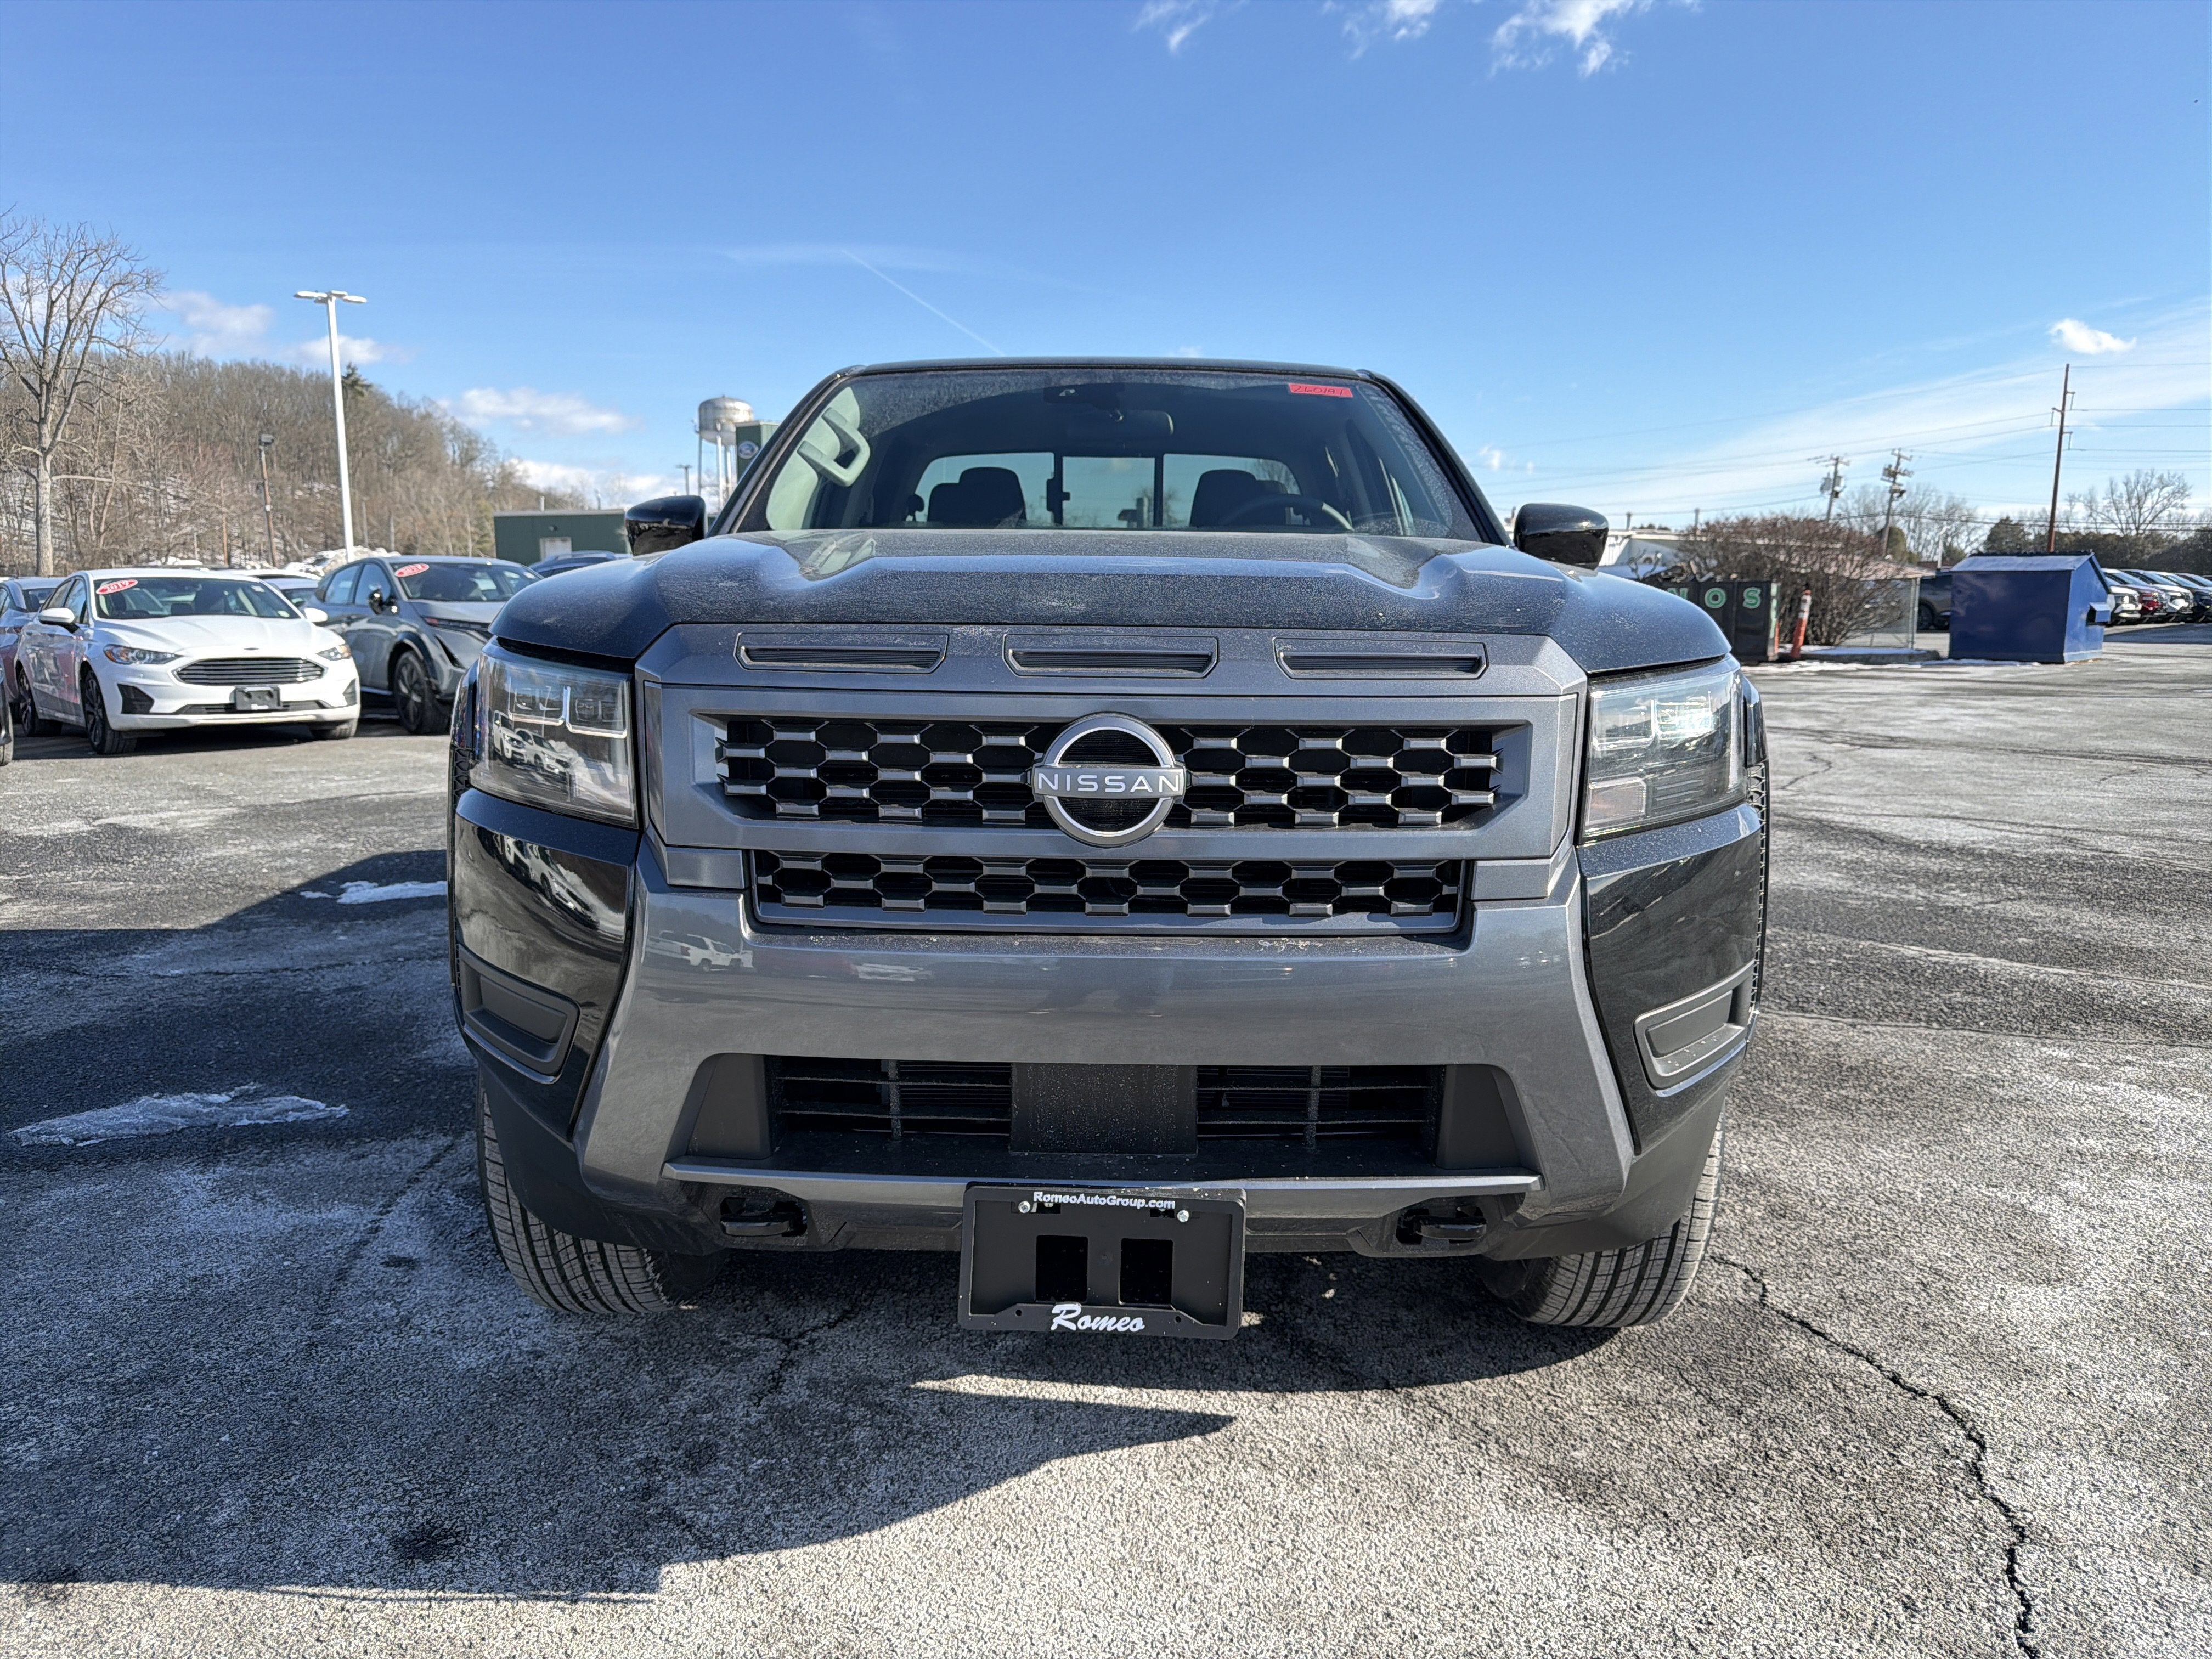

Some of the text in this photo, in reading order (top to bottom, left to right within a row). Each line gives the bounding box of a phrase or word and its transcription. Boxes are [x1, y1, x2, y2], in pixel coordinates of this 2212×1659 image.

[1038, 772, 1179, 792] NISSAN
[1034, 1191, 1175, 1209] RomeoAutoGroup.com
[1051, 1304, 1145, 1332] Romeo
